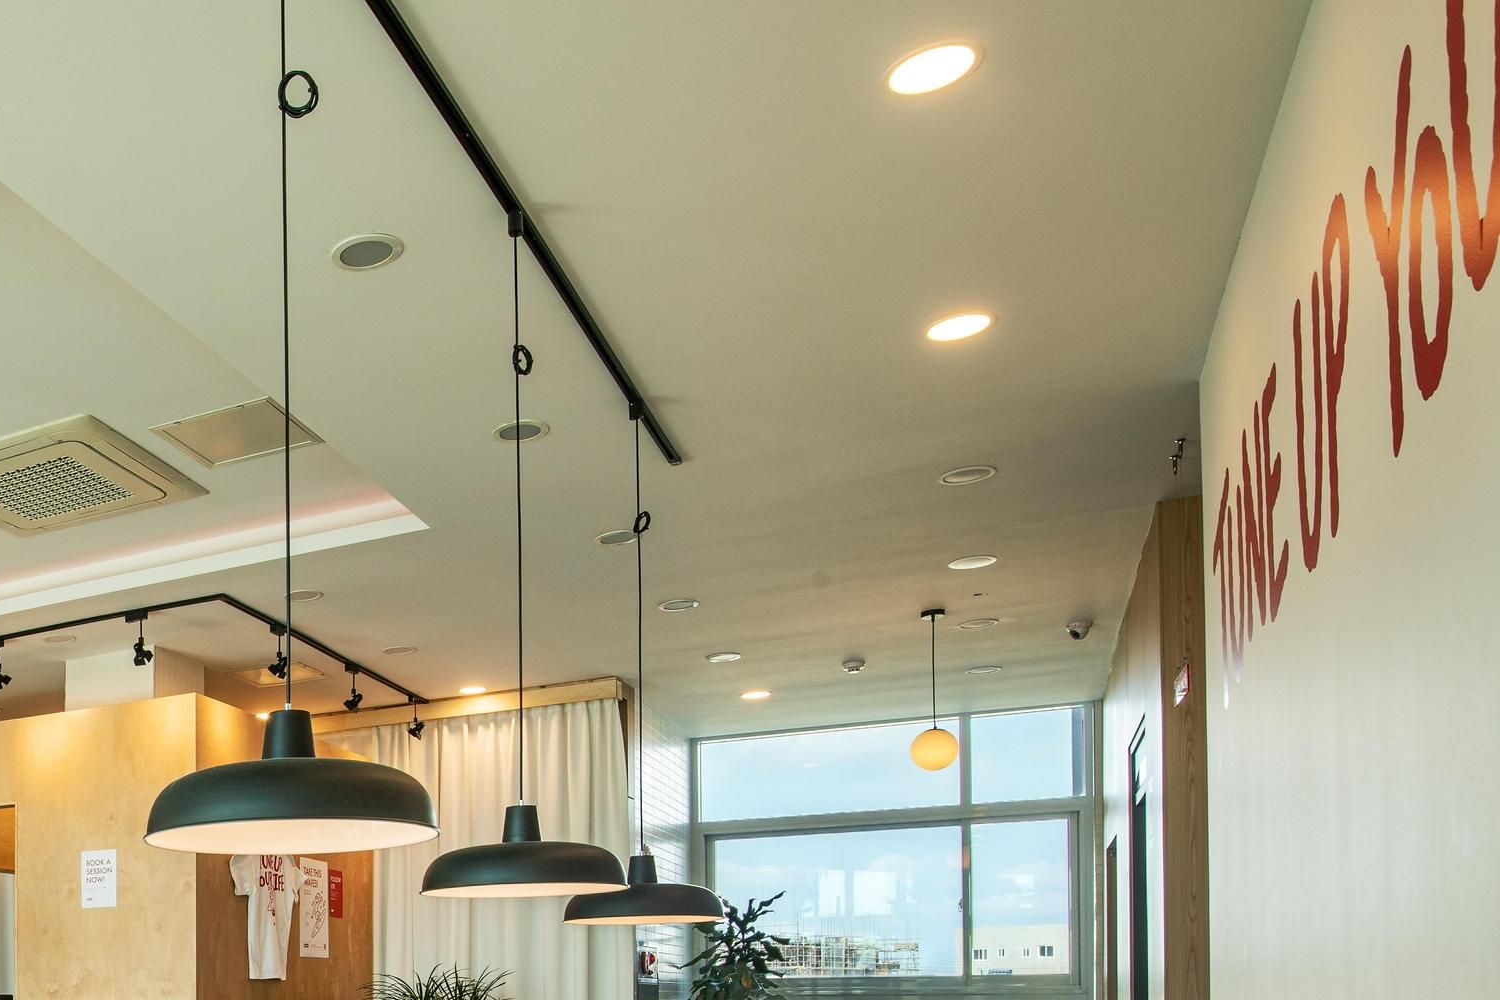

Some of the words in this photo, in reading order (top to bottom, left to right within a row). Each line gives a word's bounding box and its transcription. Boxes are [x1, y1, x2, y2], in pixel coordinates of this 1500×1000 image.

[1212, 361, 1289, 710] TUNE
[1293, 191, 1350, 574] UP
[86, 859, 105, 867] BOOK
[86, 867, 113, 875] SESSION
[86, 876, 106, 884] NOW!
